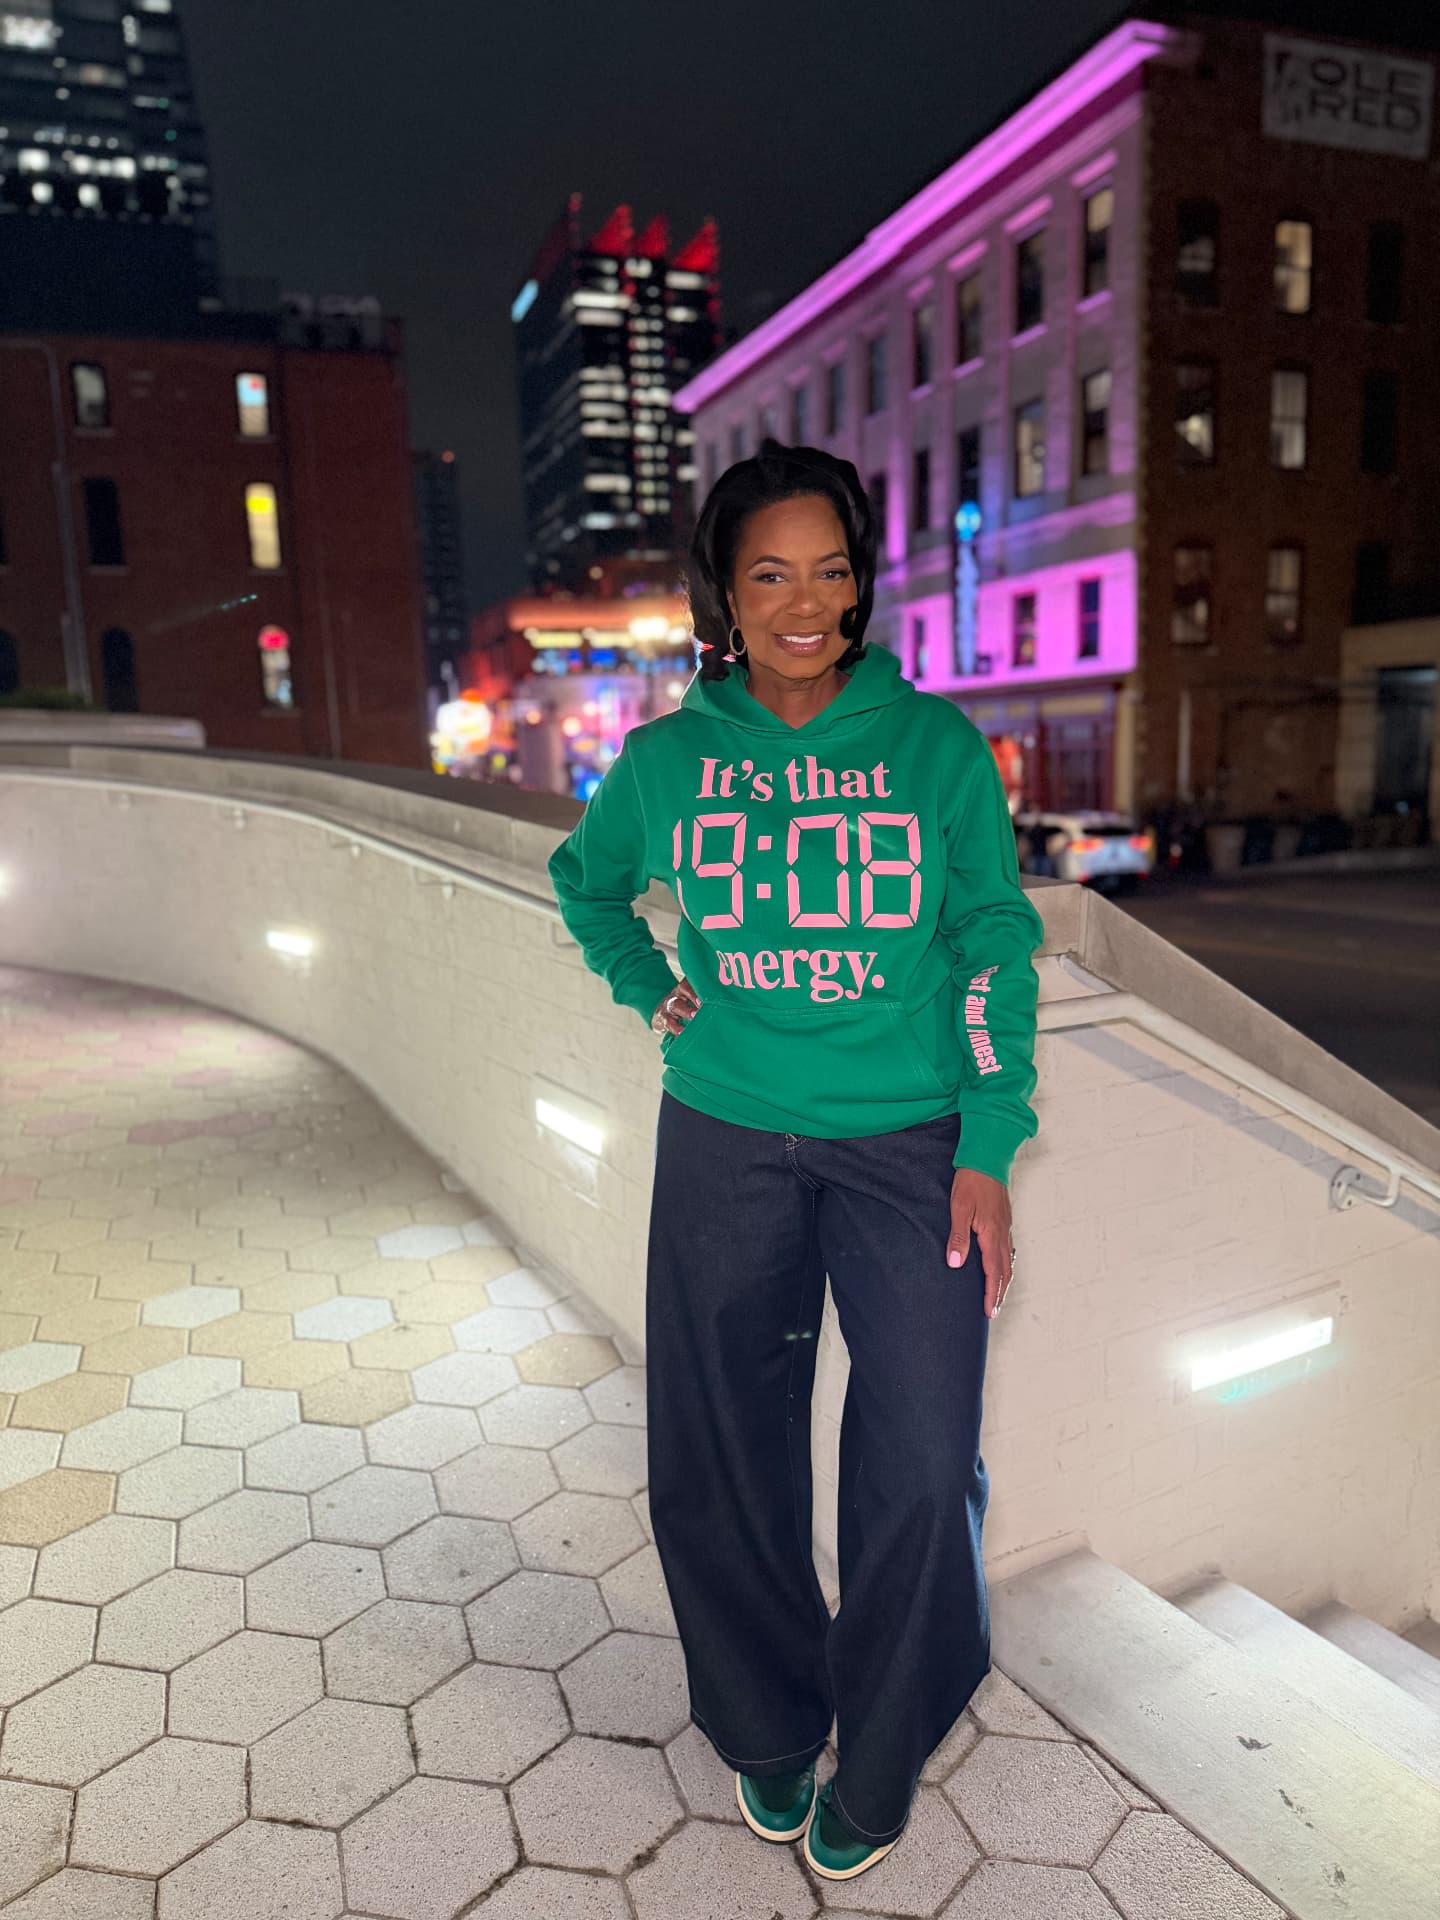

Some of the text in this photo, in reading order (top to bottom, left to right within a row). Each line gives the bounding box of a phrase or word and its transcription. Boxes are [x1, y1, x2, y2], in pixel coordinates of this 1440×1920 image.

[1310, 57, 1421, 100] OLE
[1309, 89, 1421, 133] RED
[696, 755, 892, 803] It's that
[672, 812, 922, 930] 19:08
[965, 995, 988, 1026] and
